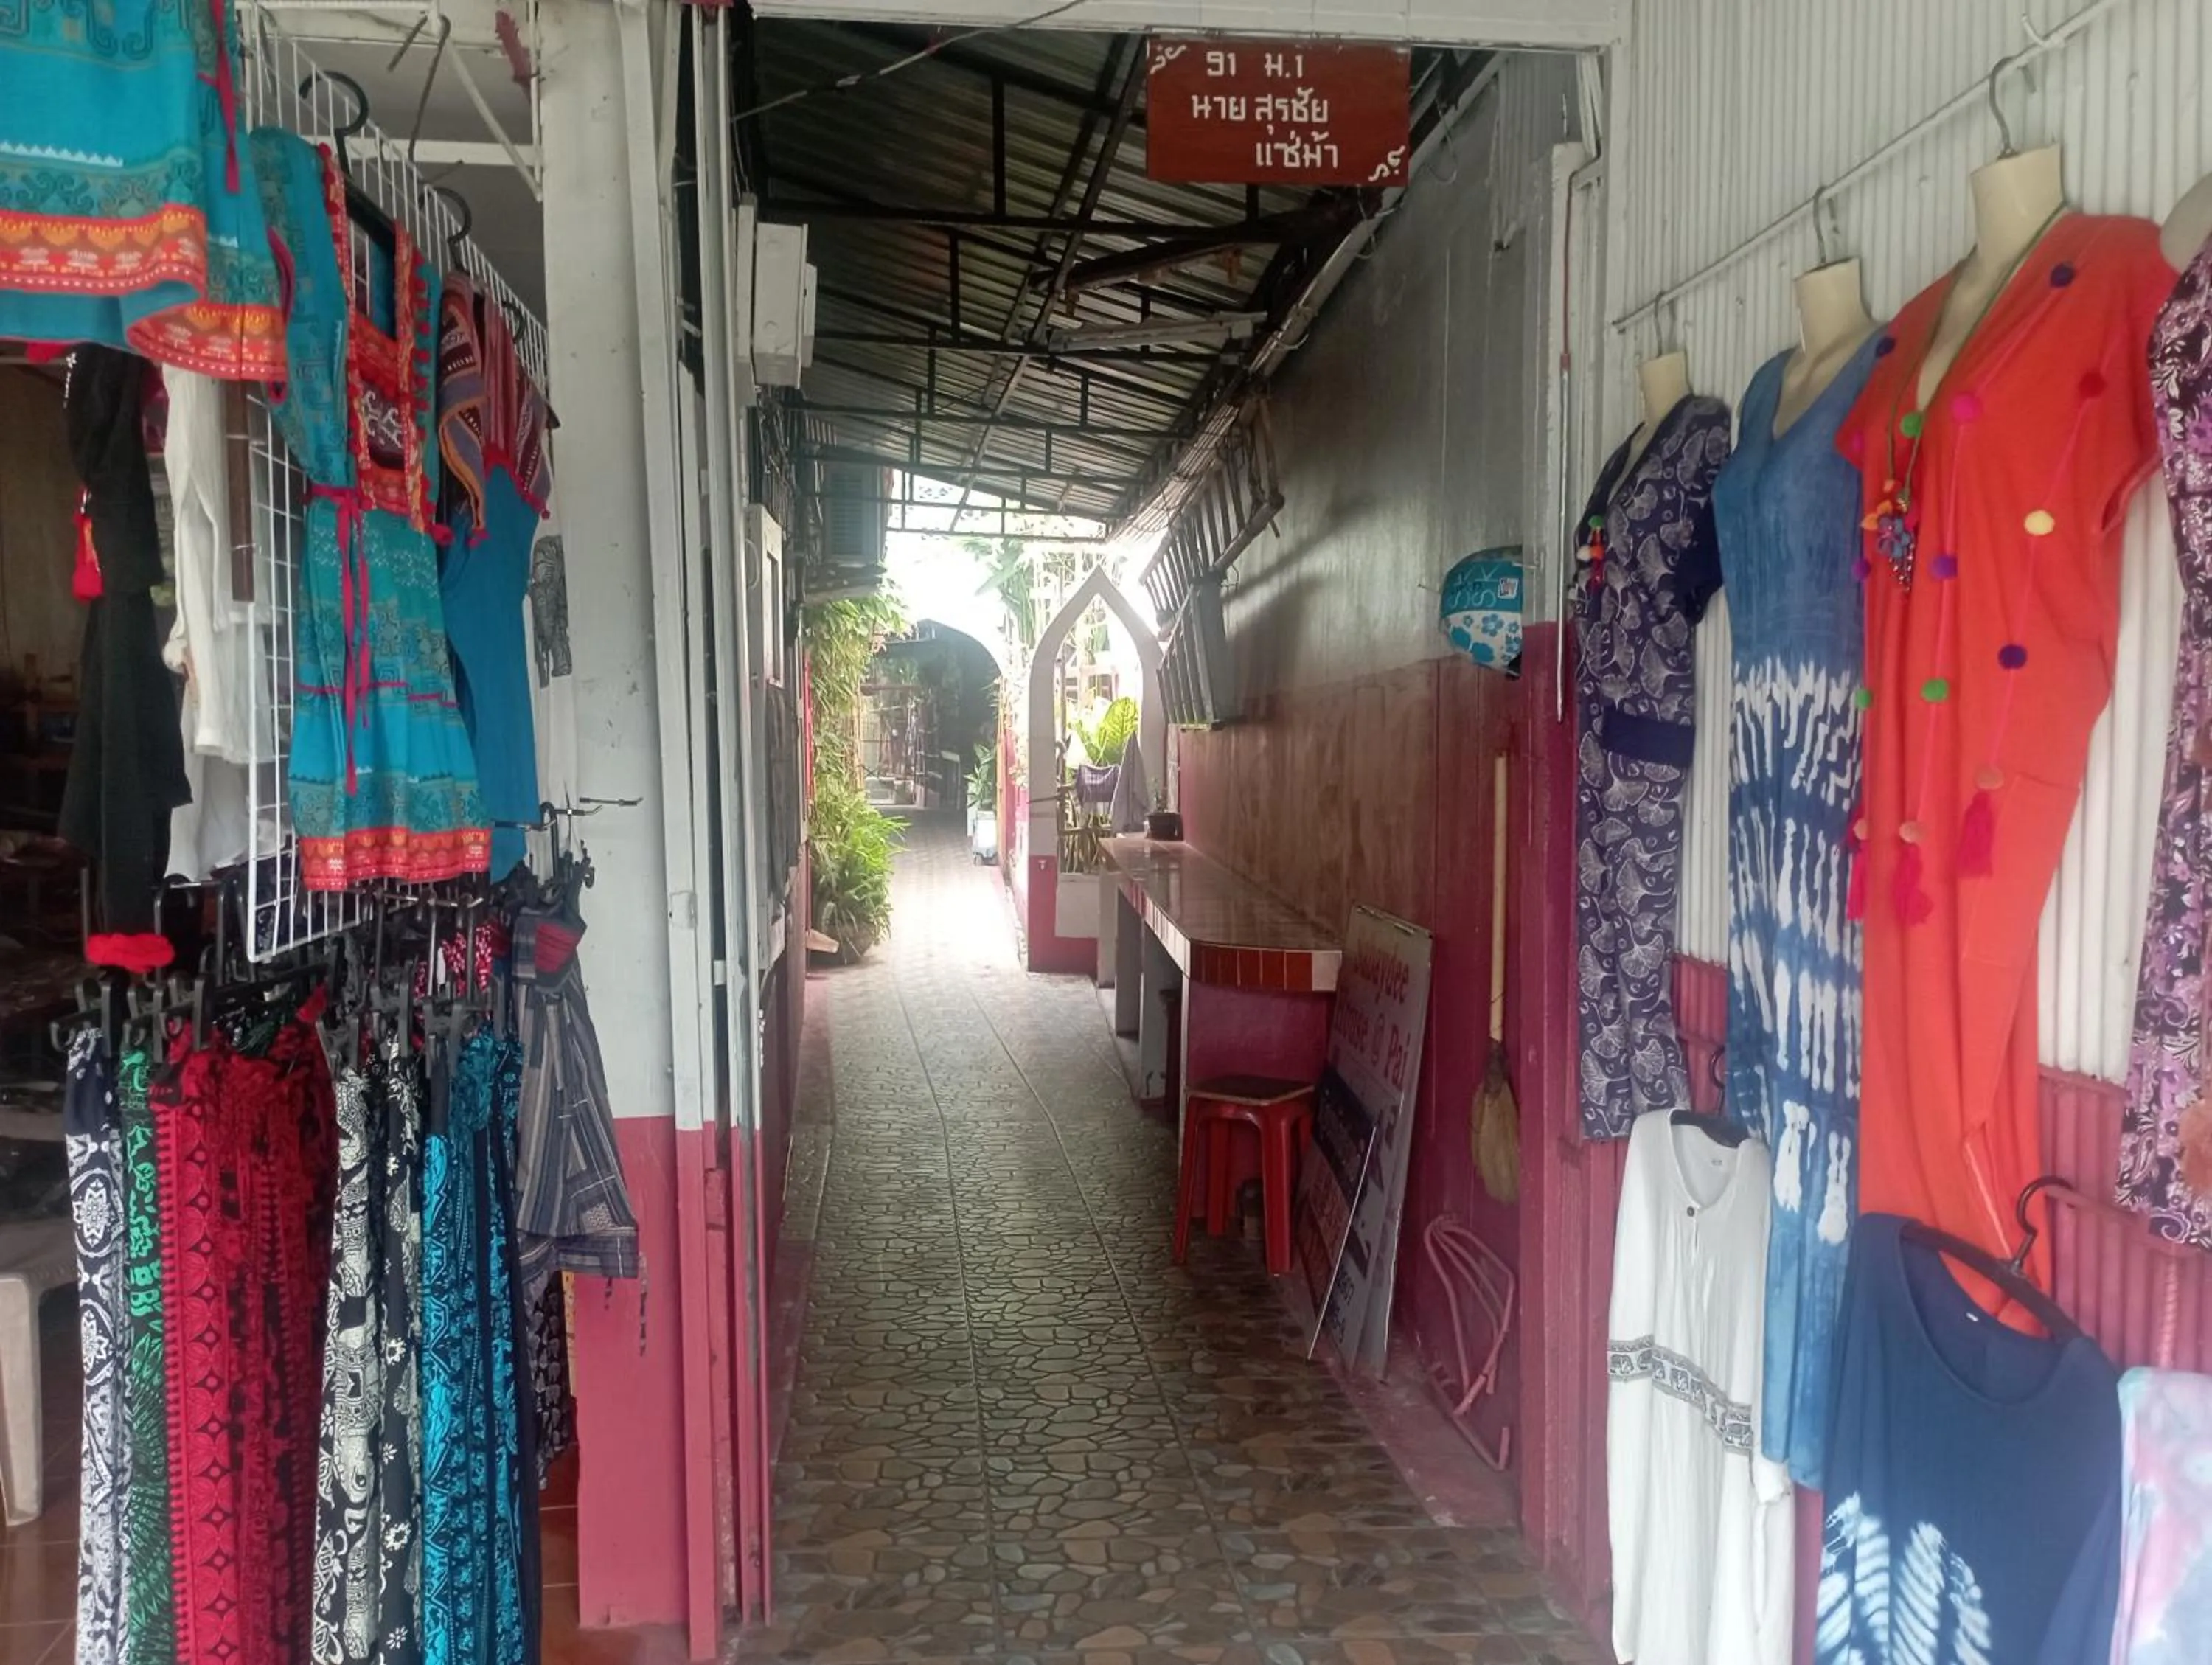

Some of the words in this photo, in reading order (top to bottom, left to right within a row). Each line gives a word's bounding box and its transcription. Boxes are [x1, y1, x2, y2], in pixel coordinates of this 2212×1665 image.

[1206, 51, 1237, 77] 91
[1264, 52, 1304, 79] ม.1
[1191, 94, 1246, 121] นาย
[1254, 86, 1328, 136] สุรชัย
[1383, 1023, 1411, 1091] Pai
